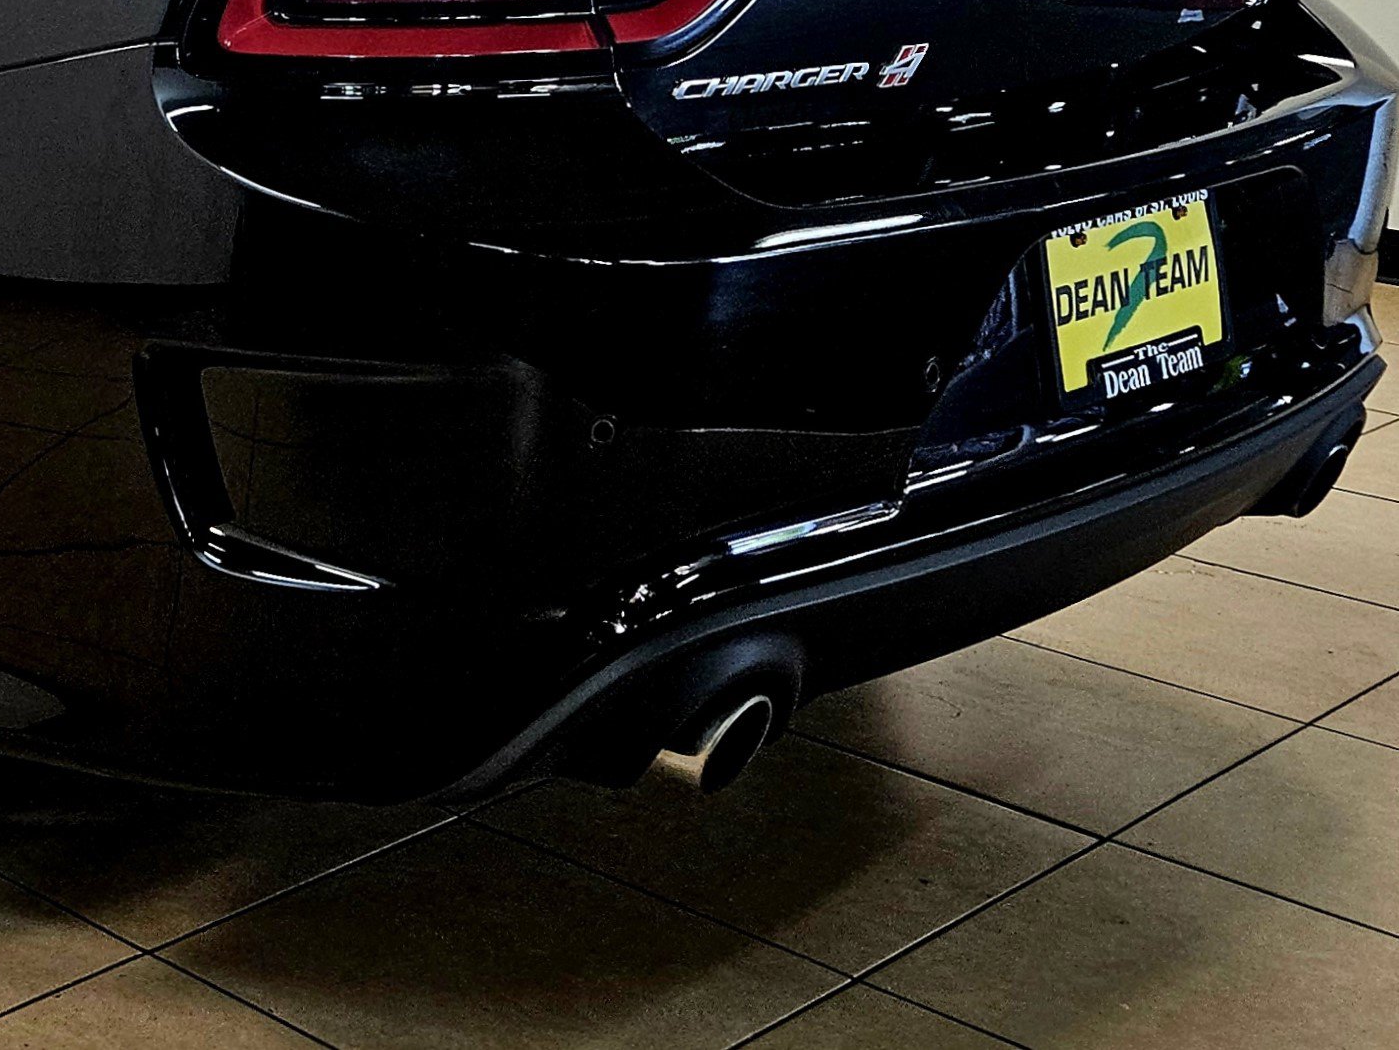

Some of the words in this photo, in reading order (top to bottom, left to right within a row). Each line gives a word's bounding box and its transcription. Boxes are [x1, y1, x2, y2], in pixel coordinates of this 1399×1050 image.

[671, 62, 869, 100] CHARGER
[1055, 267, 1130, 327] DEAN
[1140, 245, 1209, 300] TEAM
[1103, 363, 1151, 399] Dean
[1156, 344, 1204, 380] Team
[1134, 342, 1169, 361] The
